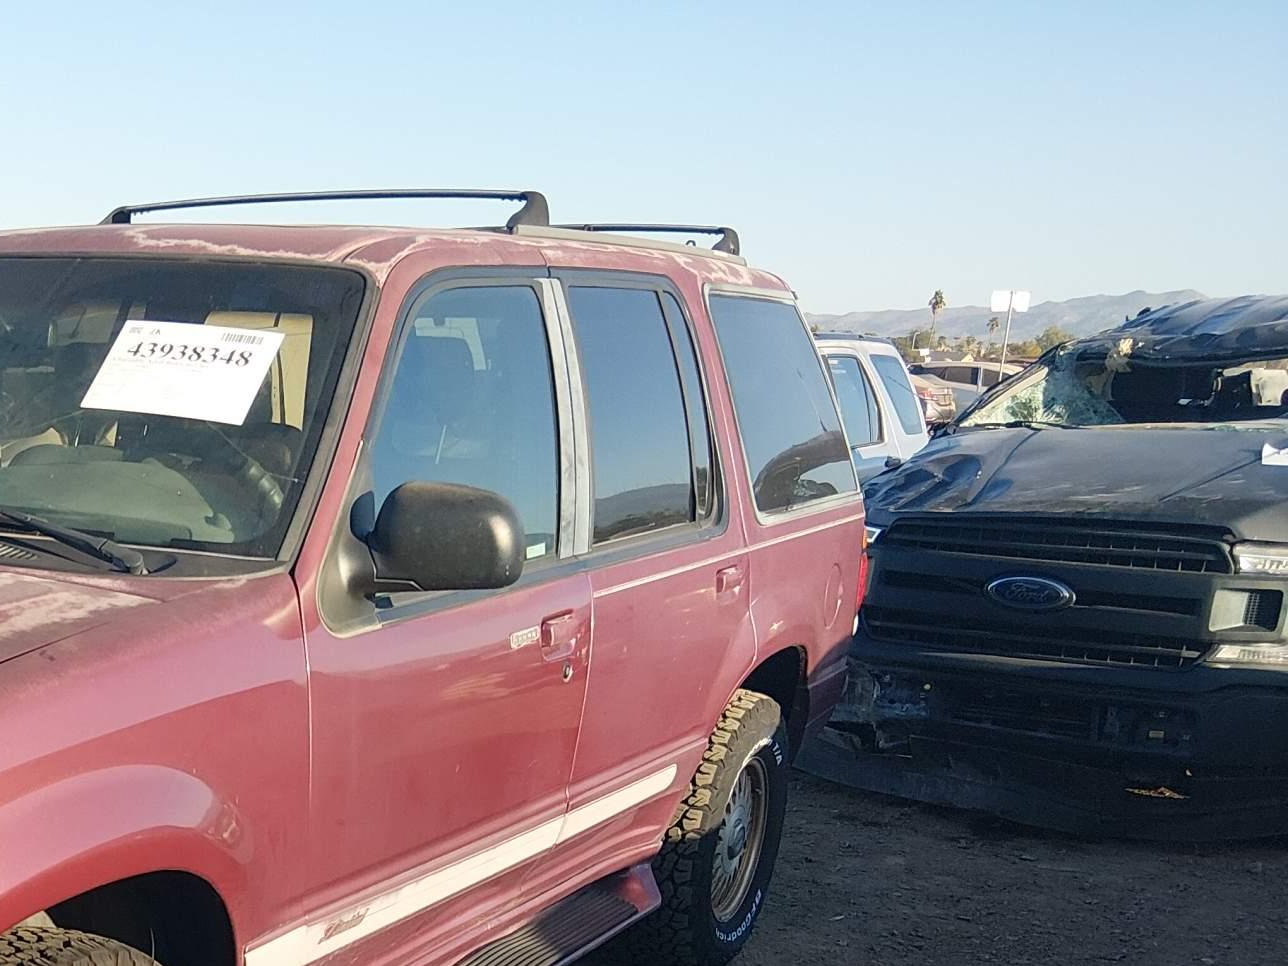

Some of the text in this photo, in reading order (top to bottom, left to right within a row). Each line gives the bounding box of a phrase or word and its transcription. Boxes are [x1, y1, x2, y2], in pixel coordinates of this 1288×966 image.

[127, 341, 253, 367] 43938348
[1005, 582, 1050, 602] Ford
[772, 742, 784, 767] T/A
[715, 888, 762, 944] BFGoodrich
